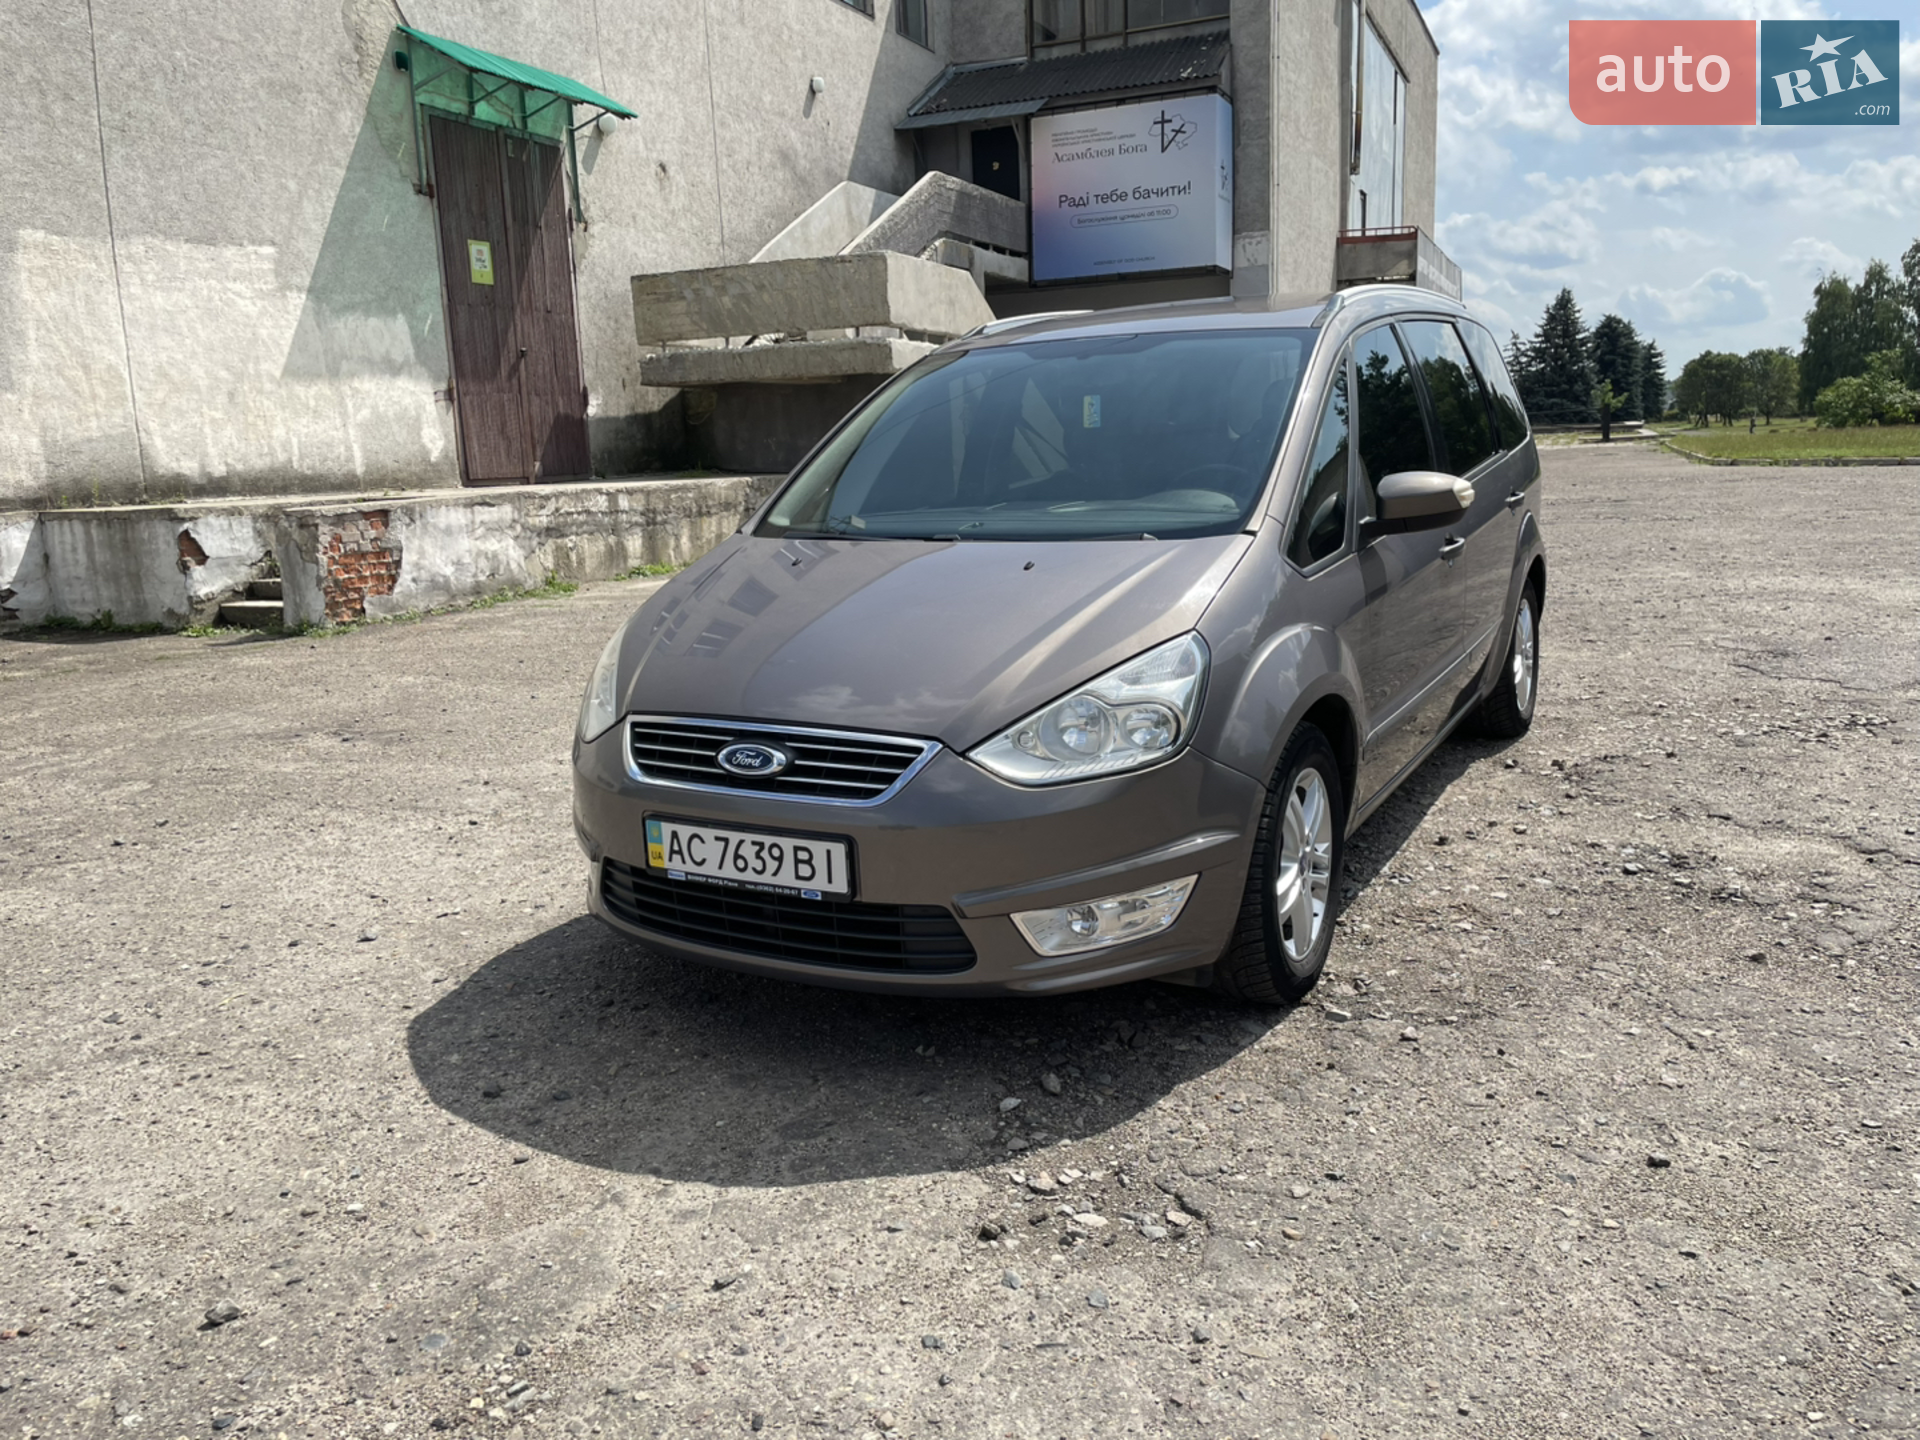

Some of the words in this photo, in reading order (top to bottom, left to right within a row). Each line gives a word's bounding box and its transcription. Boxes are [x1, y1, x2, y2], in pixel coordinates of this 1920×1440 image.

[1052, 147, 1115, 164] Асамблея
[1118, 142, 1148, 156] Бога
[1058, 191, 1090, 209] Раді
[1093, 188, 1129, 205] тебе
[1132, 180, 1192, 201] бачити!
[1156, 208, 1172, 216] 11:00
[731, 750, 763, 767] Ford
[651, 850, 663, 861] UA
